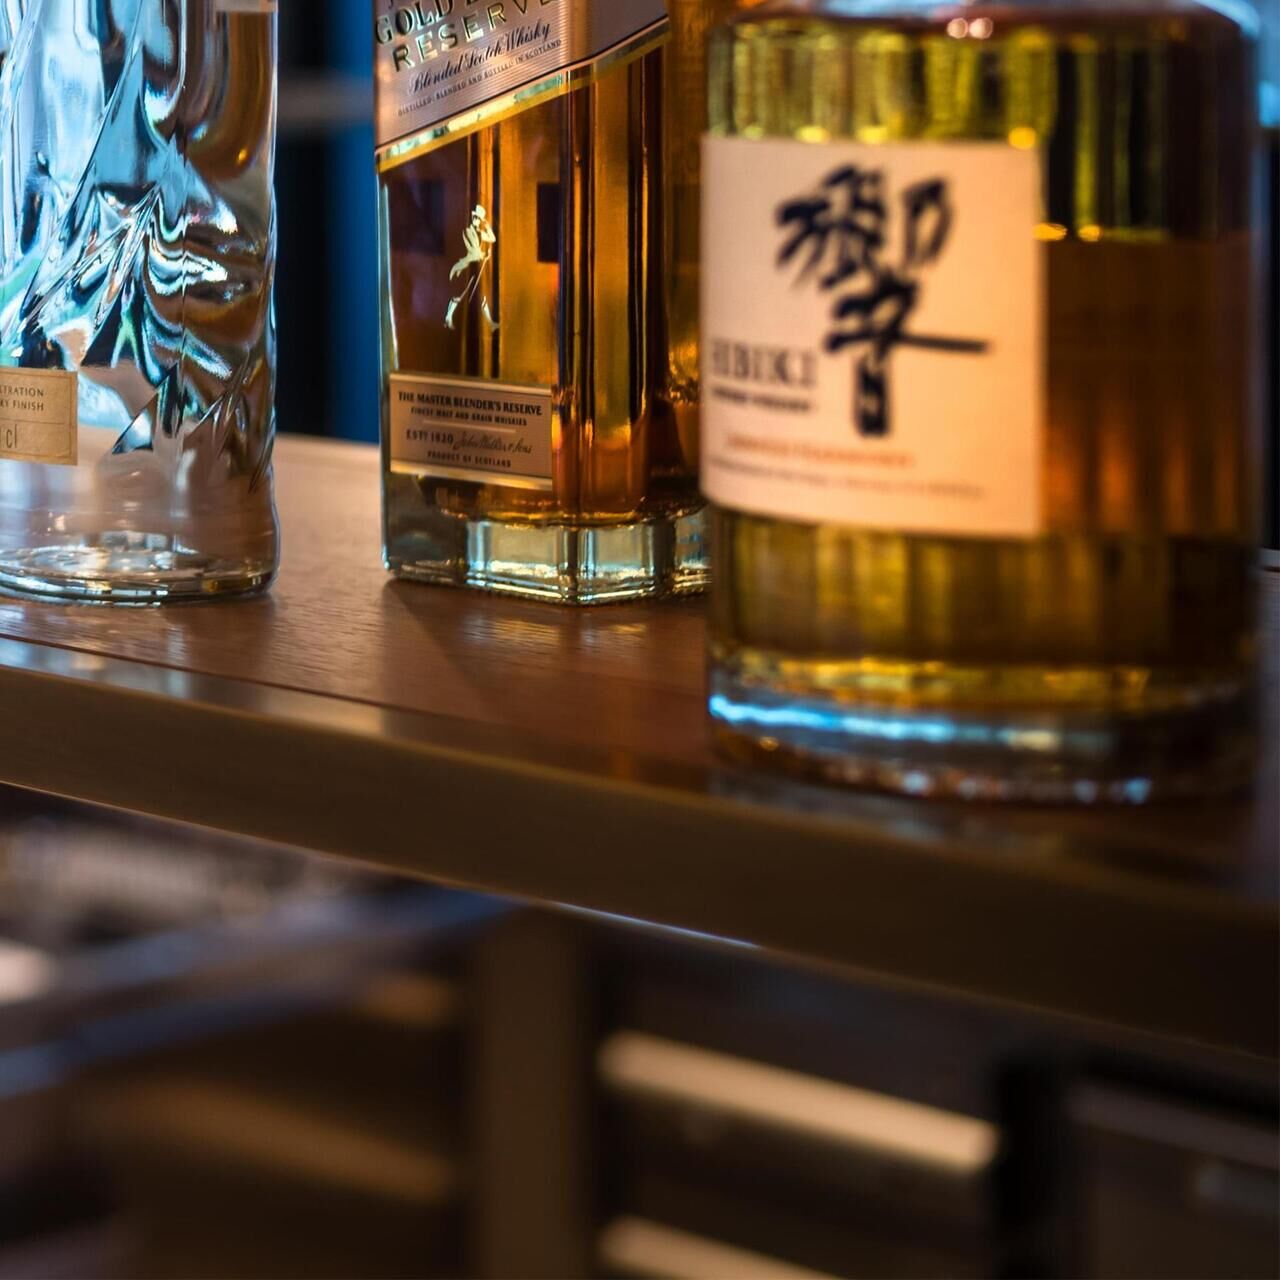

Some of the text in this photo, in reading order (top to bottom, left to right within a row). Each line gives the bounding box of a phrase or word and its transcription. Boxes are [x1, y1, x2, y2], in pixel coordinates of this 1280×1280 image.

[409, 18, 551, 96] Blended Scotch Whisky
[468, 74, 483, 87] AND
[525, 39, 562, 63] SCOTLAND
[12, 399, 45, 412] FINISH
[398, 391, 543, 416] THE MASTER BLENDER'S RESERVE
[410, 406, 434, 416] FINEST
[455, 411, 469, 420] AND
[494, 415, 528, 427] WHISKIES
[5, 423, 18, 449] cl
[430, 431, 454, 444] 1820
[427, 450, 512, 468] PRODUCT OF SCOTLAND
